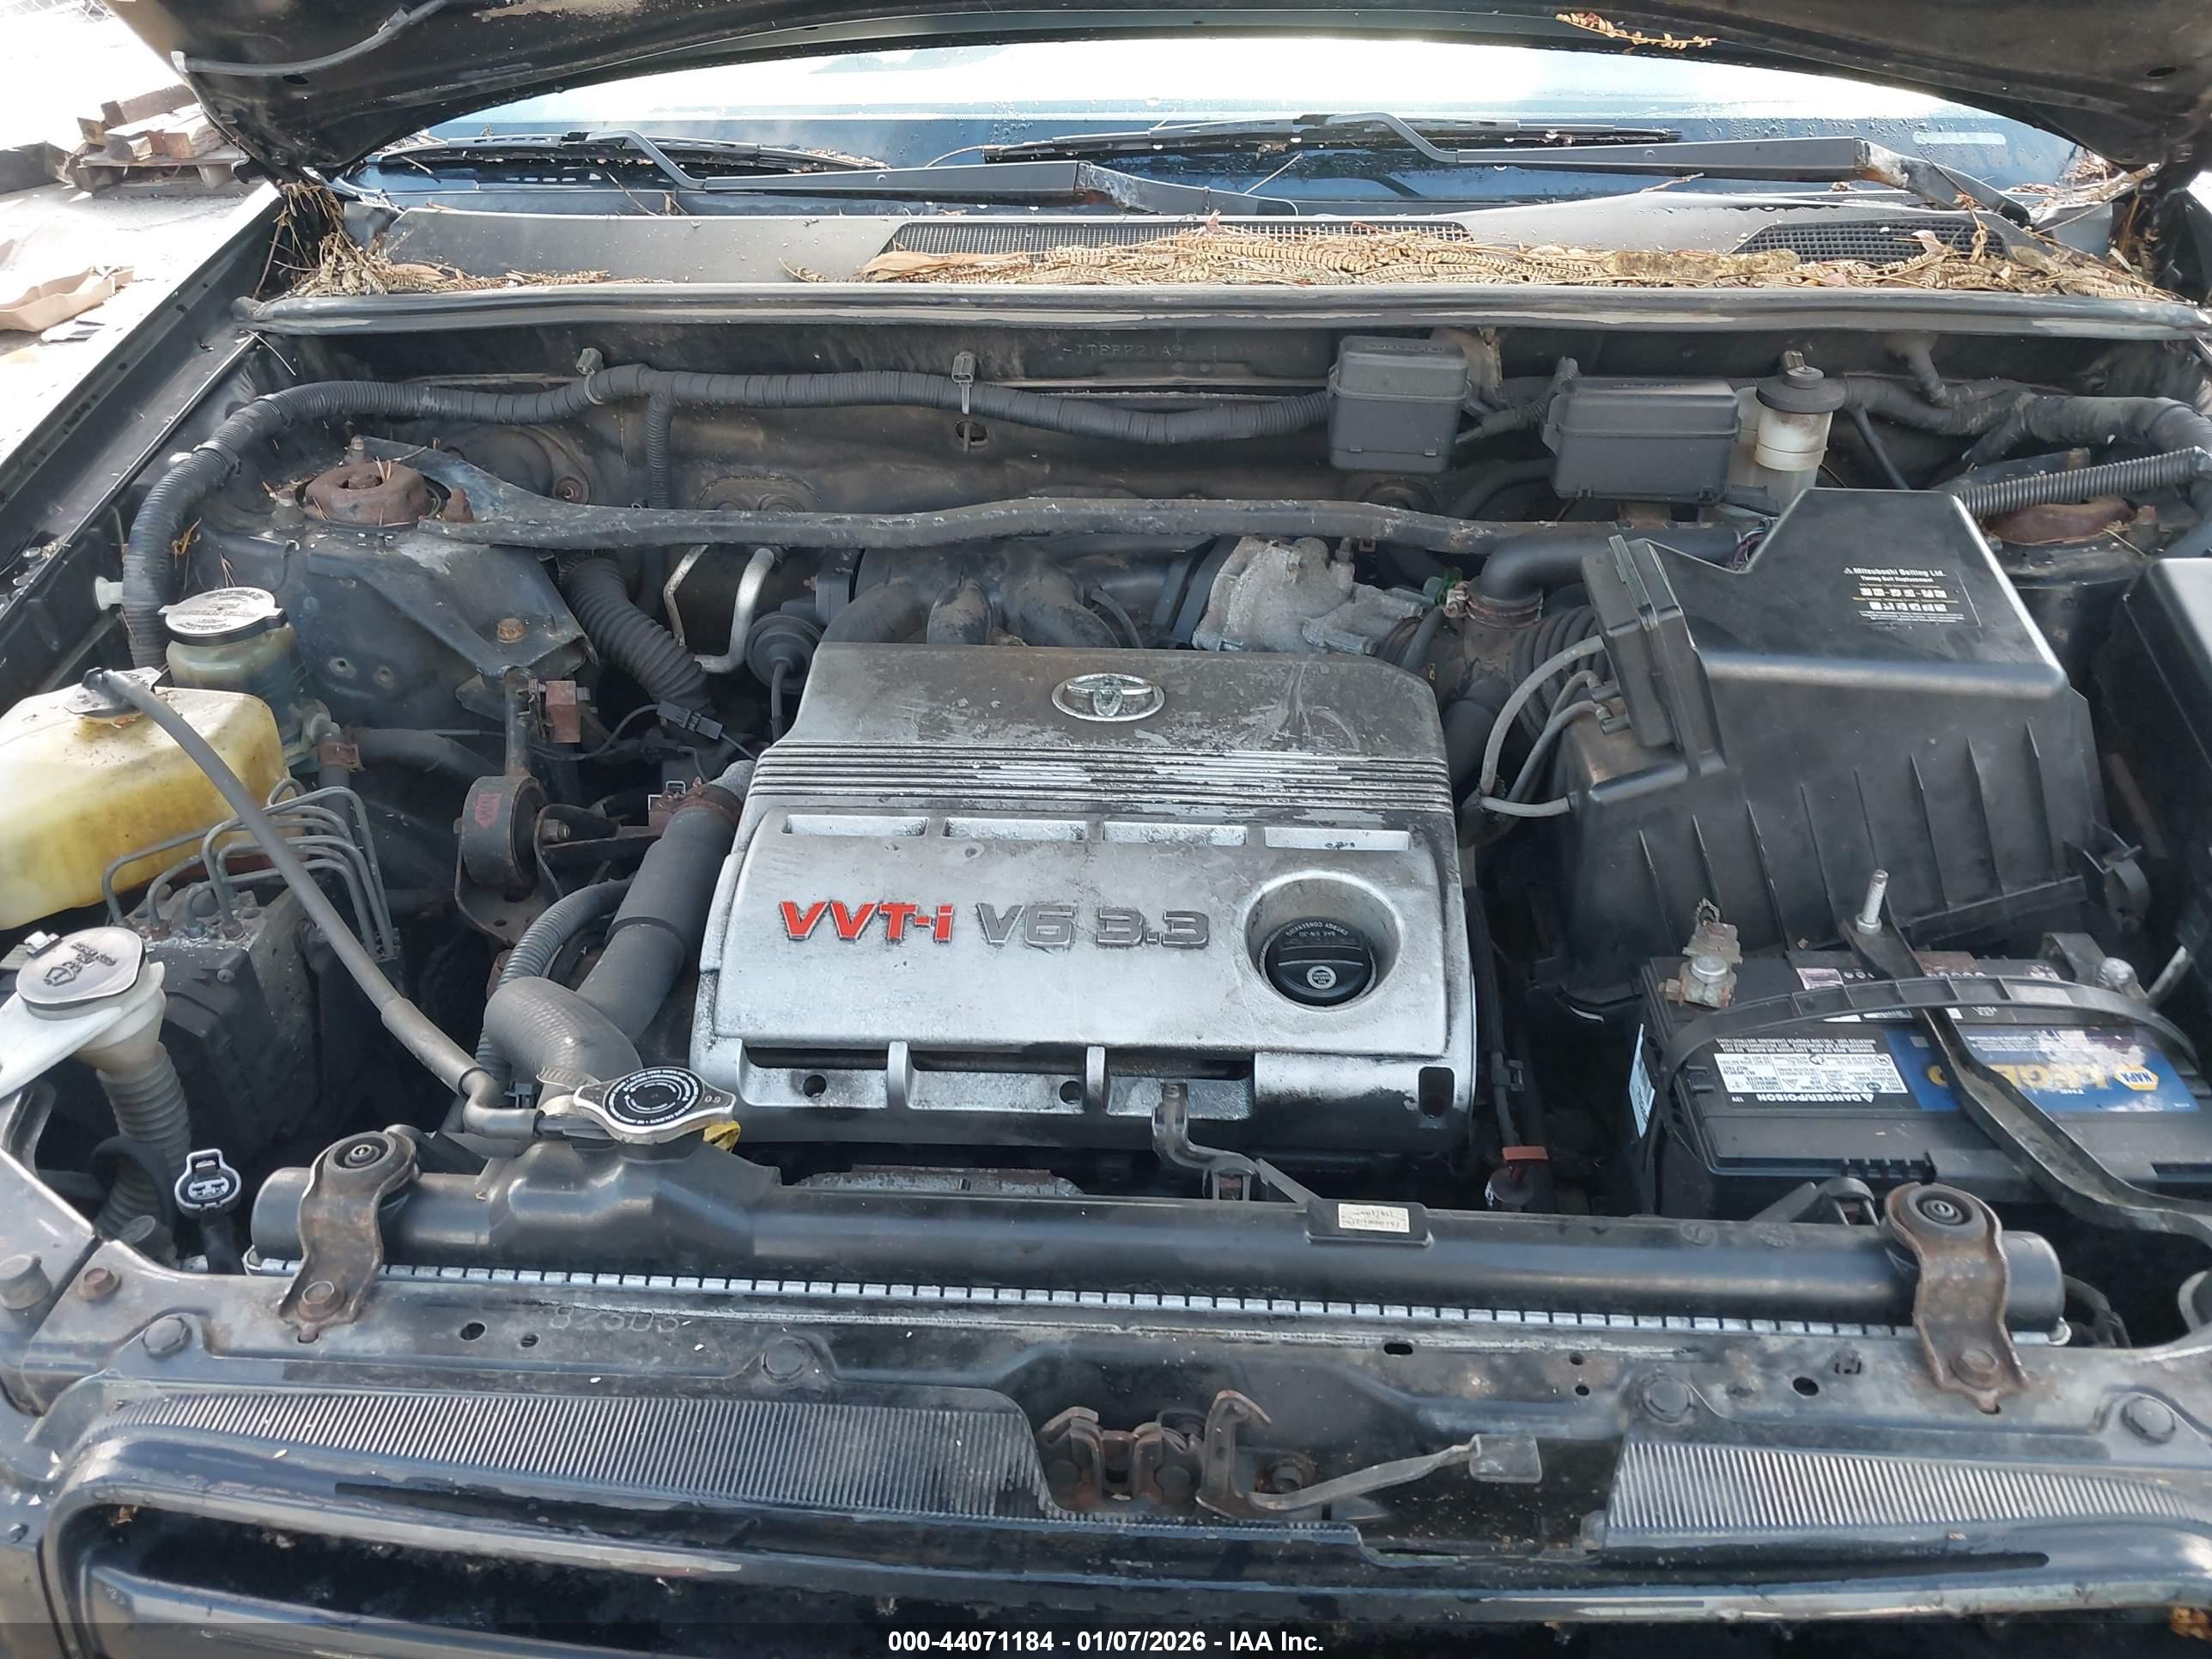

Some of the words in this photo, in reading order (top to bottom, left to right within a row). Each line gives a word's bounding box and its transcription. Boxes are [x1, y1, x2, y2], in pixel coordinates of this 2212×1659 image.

[1852, 567, 1899, 576] Mitsuboshi
[1899, 568, 1929, 578] Belting
[779, 900, 954, 942] VVT-i
[975, 902, 1078, 947] V6
[1096, 906, 1212, 948] 3.3
[1285, 921, 1323, 937] CONSERVING
[1325, 922, 1349, 936] ENERGY
[2120, 1071, 2154, 1085] NAPA
[1756, 1093, 1863, 1102] DANGER/POISON
